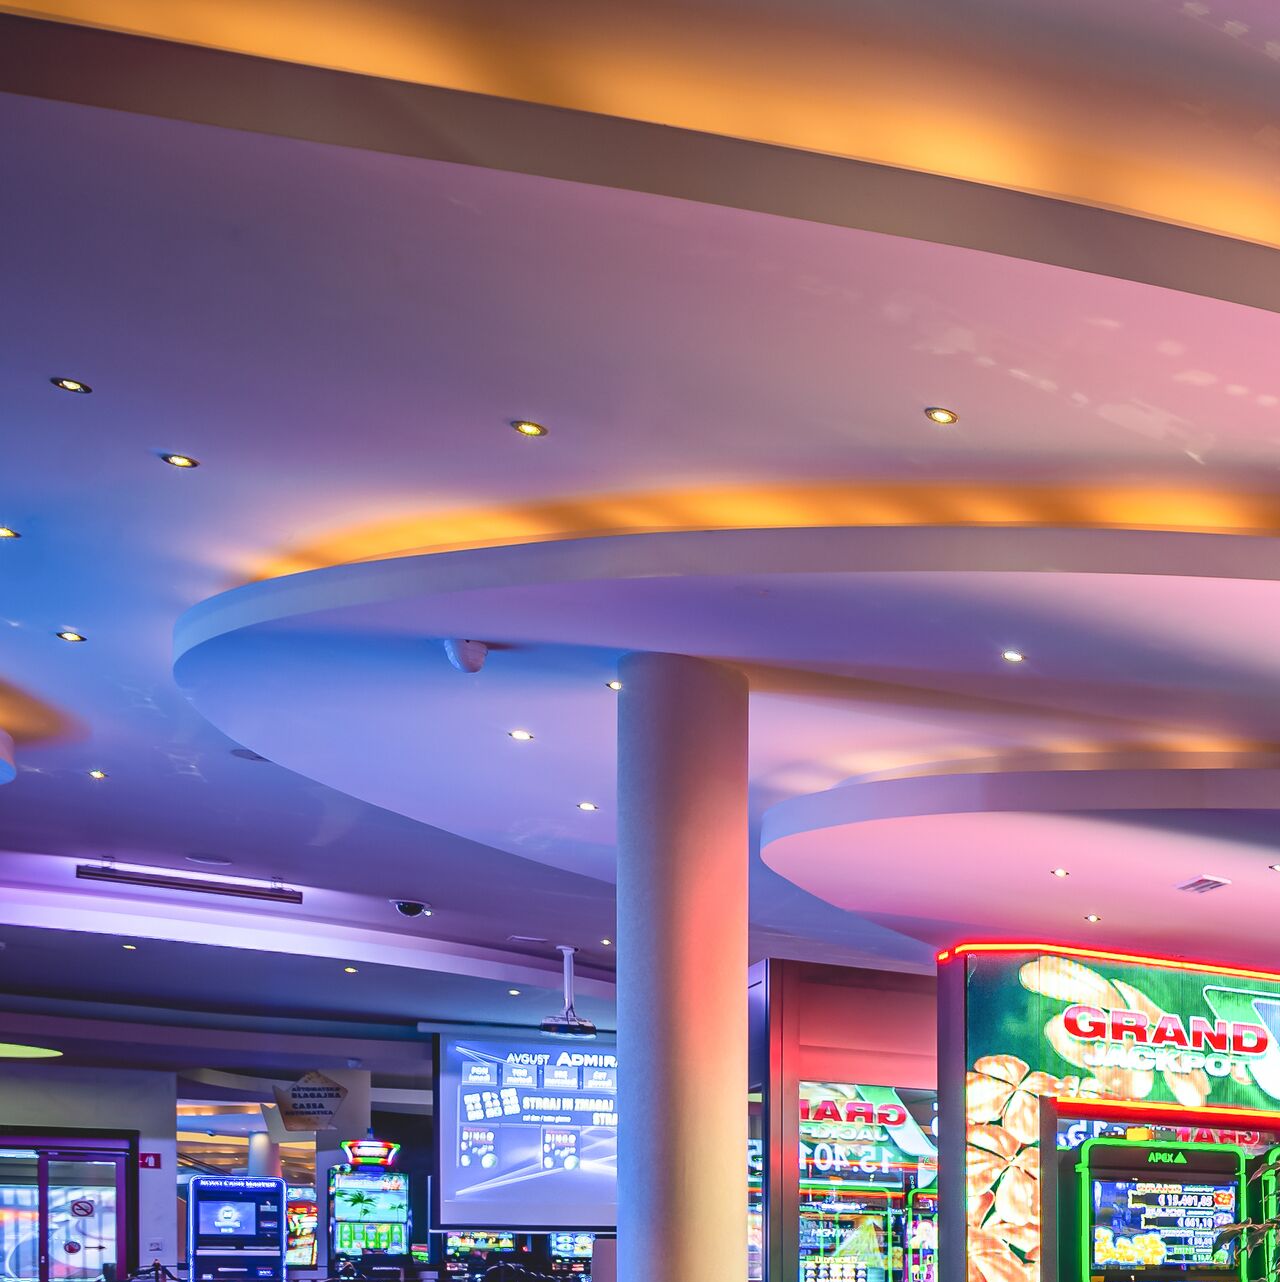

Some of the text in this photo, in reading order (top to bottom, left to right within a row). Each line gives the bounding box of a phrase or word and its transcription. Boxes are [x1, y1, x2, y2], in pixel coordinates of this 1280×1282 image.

[1063, 1003, 1270, 1056] GRAND
[506, 1051, 617, 1068] AVGUST ADMIR
[1085, 1042, 1252, 1078] JACKPOT
[1148, 1152, 1174, 1163] APEX
